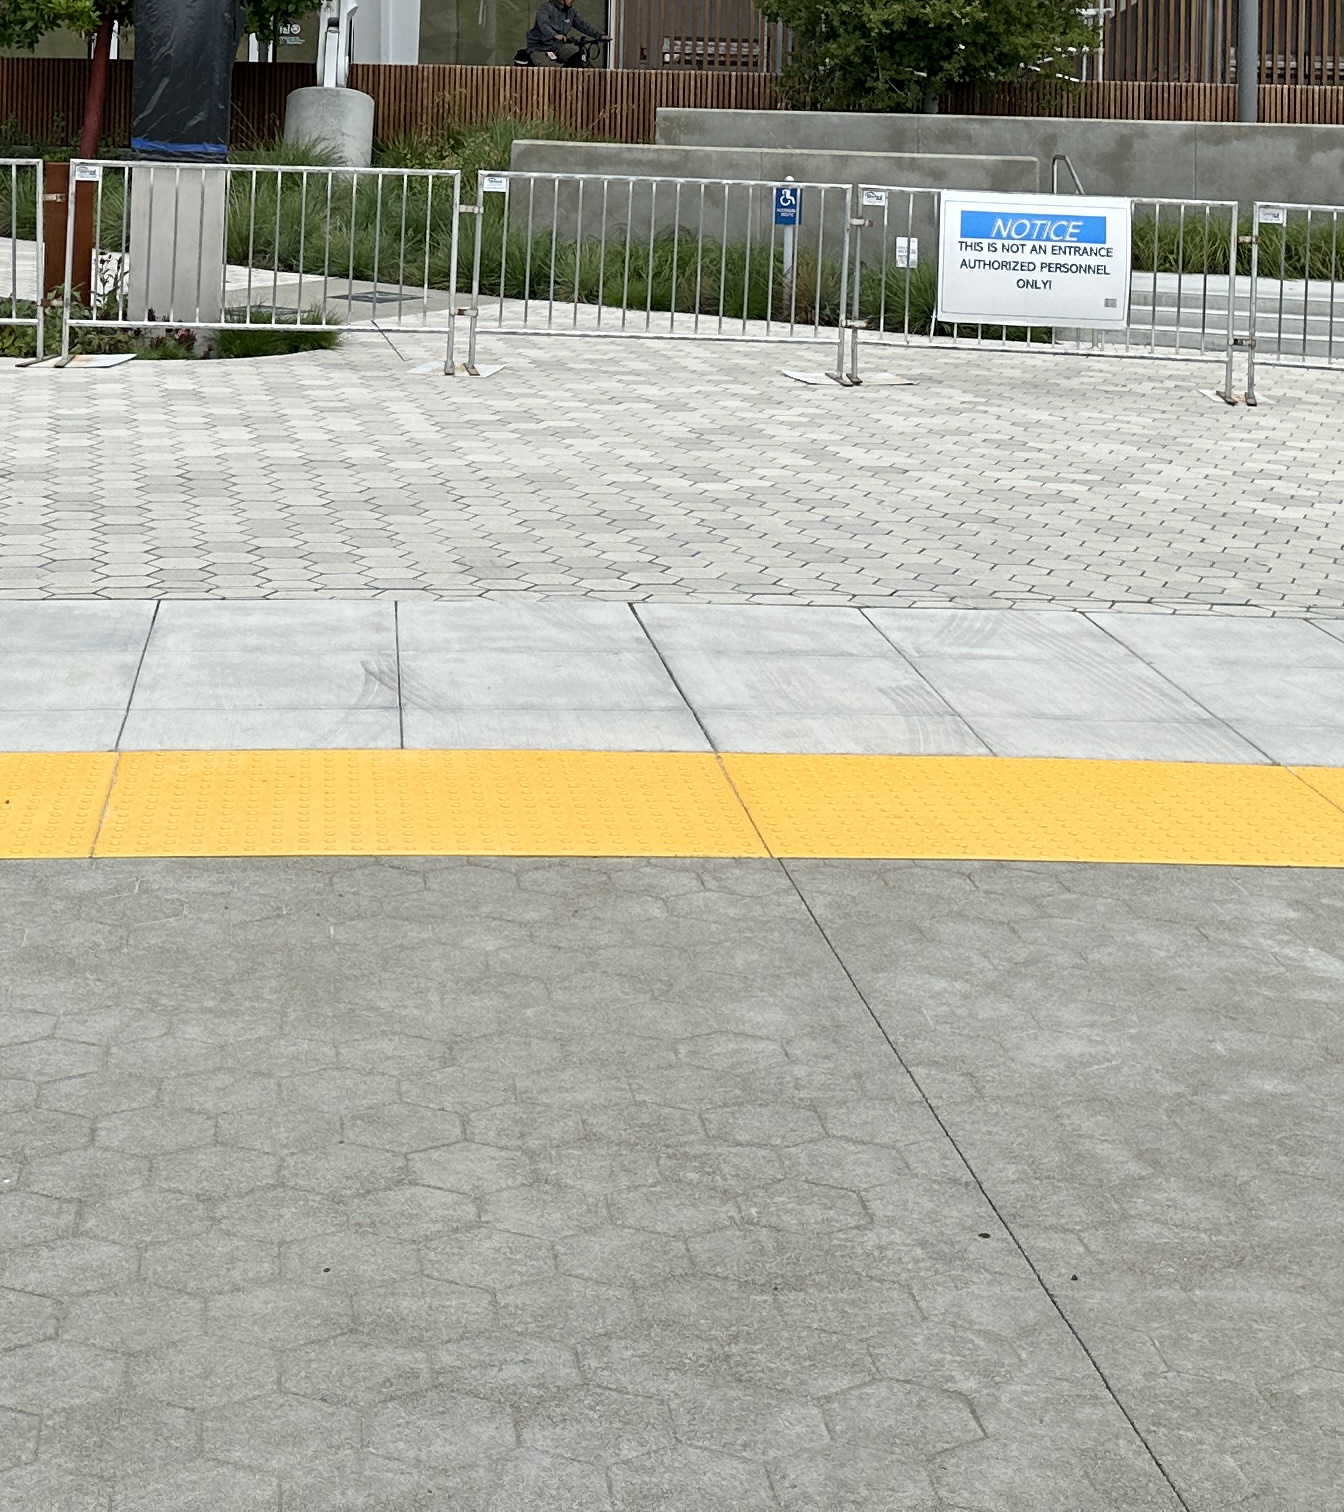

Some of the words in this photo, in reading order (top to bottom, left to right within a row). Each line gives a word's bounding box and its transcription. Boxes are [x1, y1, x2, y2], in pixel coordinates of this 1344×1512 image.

[991, 218, 1083, 241] NOTICE
[958, 241, 983, 252] THIS
[987, 242, 997, 253] IS
[1001, 242, 1026, 254] NOT
[1030, 244, 1047, 255] AN
[1051, 245, 1114, 258] ENTRANCE
[960, 259, 1036, 272] AUTHORIZED
[1040, 262, 1111, 276] PERSONNEL
[1016, 278, 1052, 290] ONLY!
